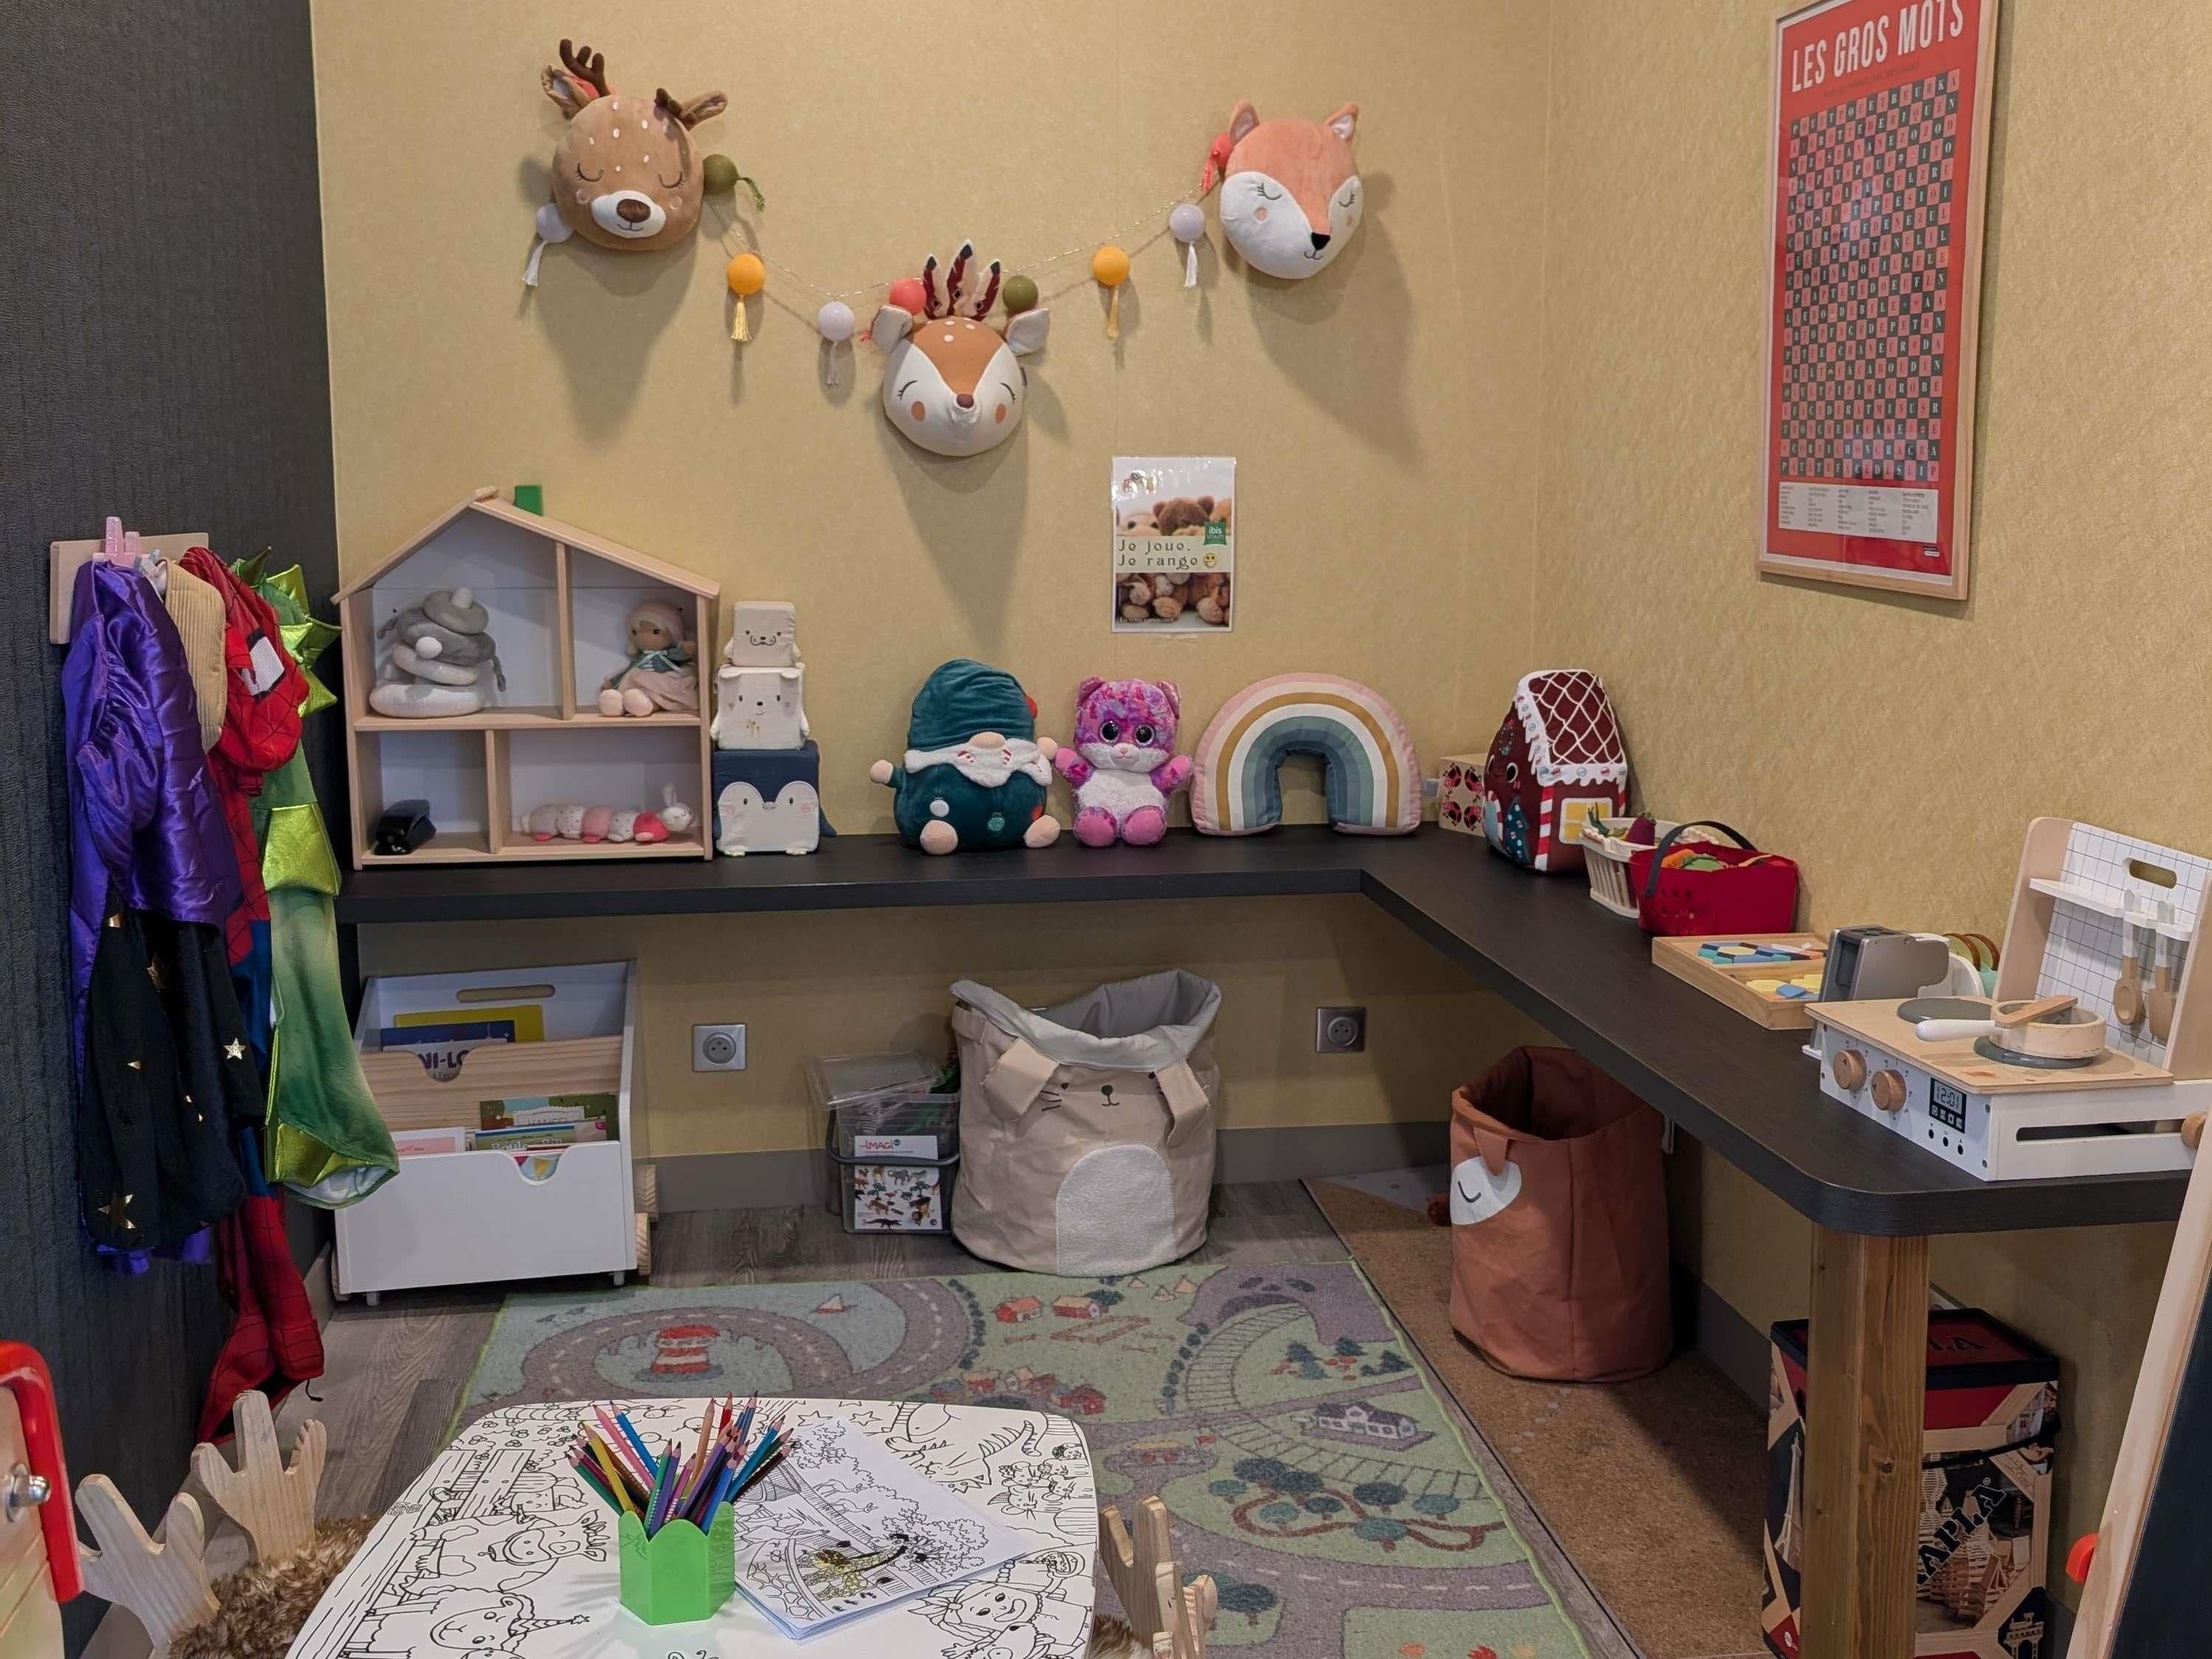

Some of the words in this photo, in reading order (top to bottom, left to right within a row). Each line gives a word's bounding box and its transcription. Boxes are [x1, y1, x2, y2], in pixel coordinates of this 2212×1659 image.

[1792, 40, 1827, 92] LES
[1834, 15, 1889, 77] GROS
[1897, 0, 1964, 56] MOTS
[1208, 526, 1222, 535] ibis
[1118, 540, 1136, 552] Je
[1118, 554, 1136, 566] Je
[1147, 556, 1198, 571] range
[1917, 1484, 2007, 1586] APLA
